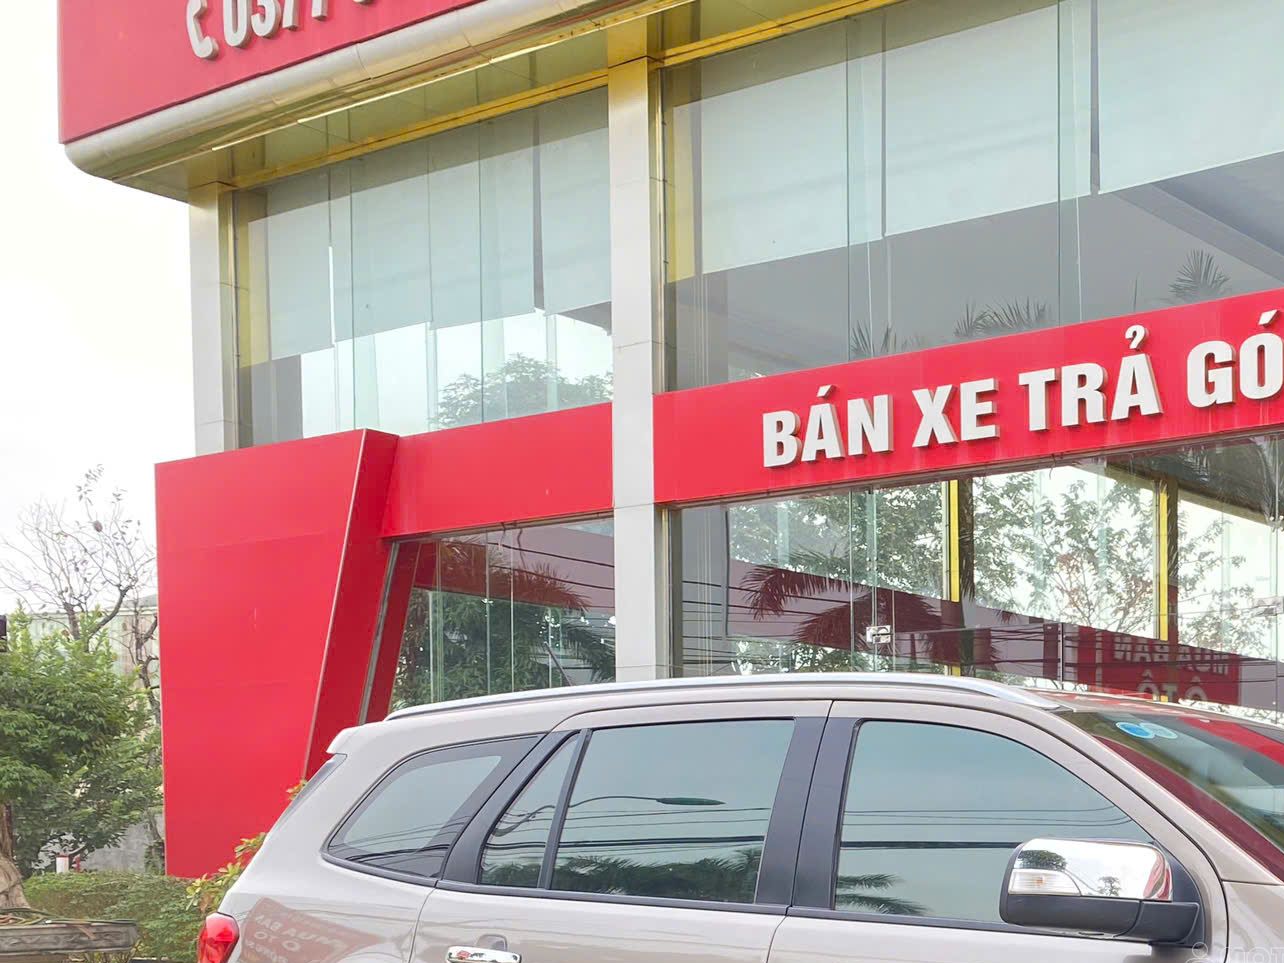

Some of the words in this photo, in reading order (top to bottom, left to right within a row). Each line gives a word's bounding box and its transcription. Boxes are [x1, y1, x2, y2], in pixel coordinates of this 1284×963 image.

[762, 386, 894, 468] BÁN
[912, 379, 1000, 448] XE
[1019, 325, 1164, 432] TRẢ
